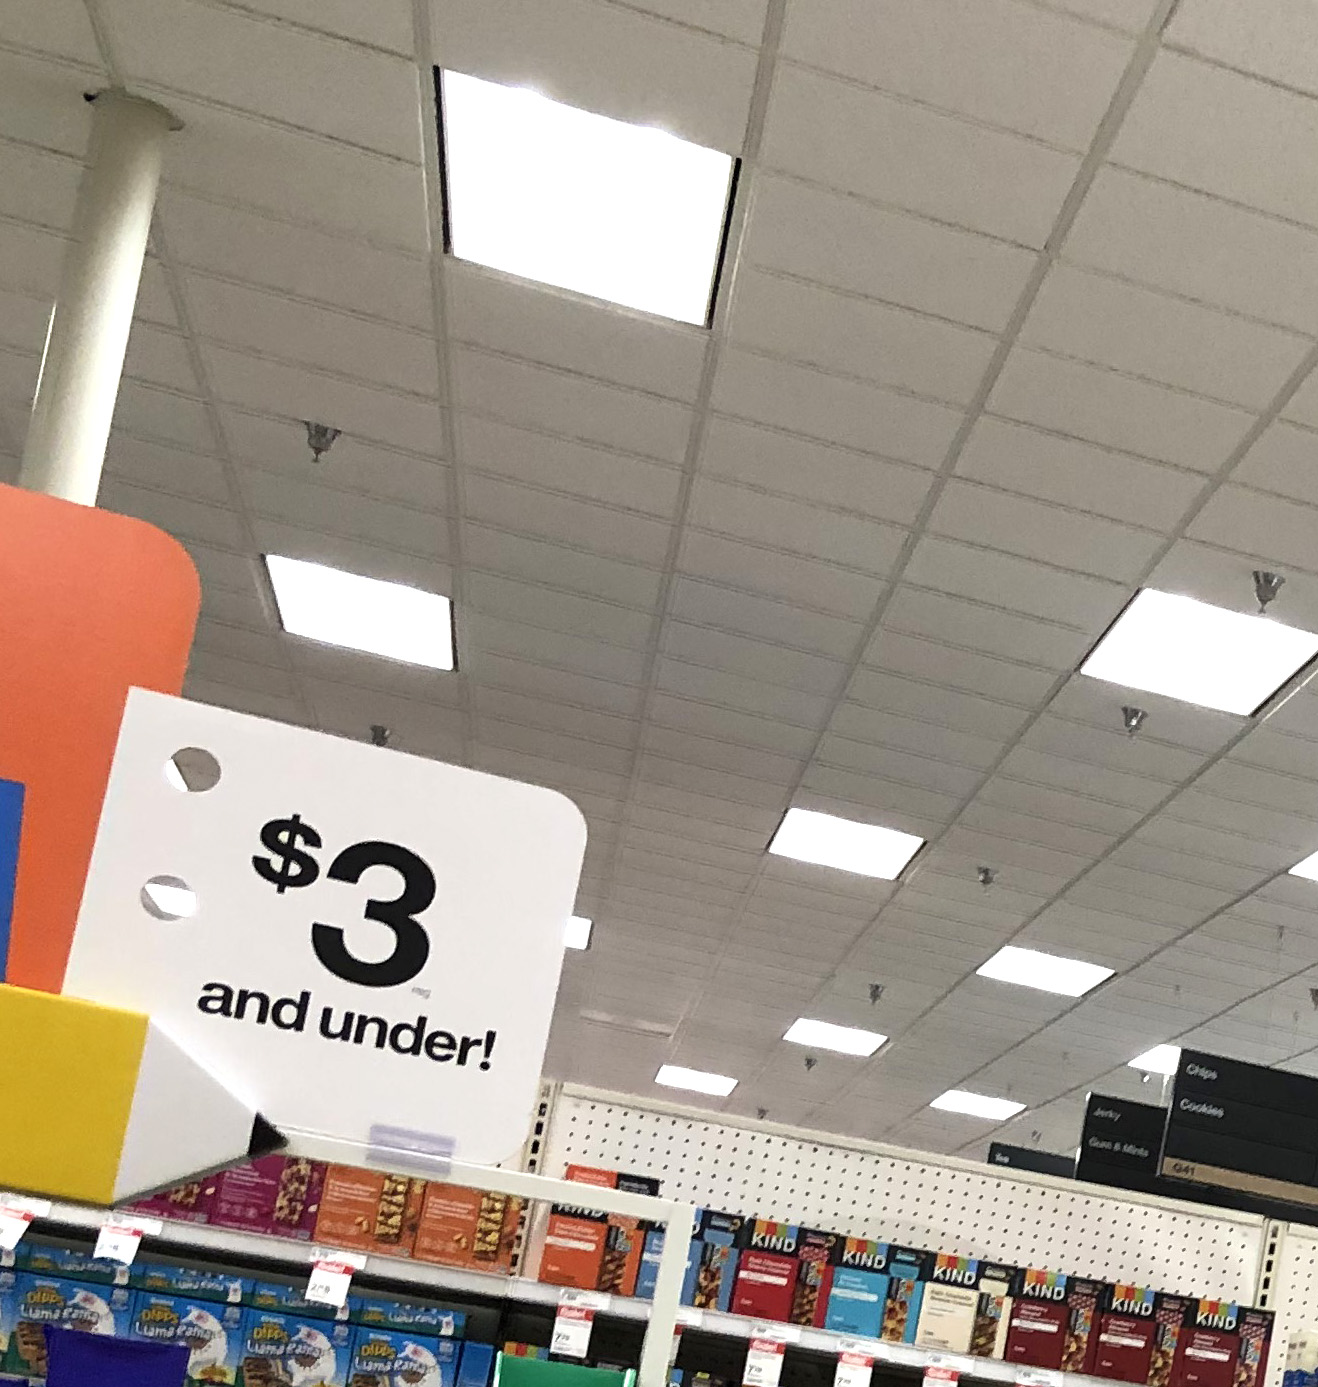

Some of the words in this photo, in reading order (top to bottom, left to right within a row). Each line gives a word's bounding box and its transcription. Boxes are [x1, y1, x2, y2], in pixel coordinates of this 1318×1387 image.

[198, 981, 310, 1032] and
[319, 1003, 496, 1072] under!
[1180, 1098, 1225, 1118] Cookies
[751, 1232, 797, 1253] KIND
[842, 1251, 886, 1269] KIND
[933, 1266, 976, 1285] KIND
[1023, 1282, 1065, 1300] KIND
